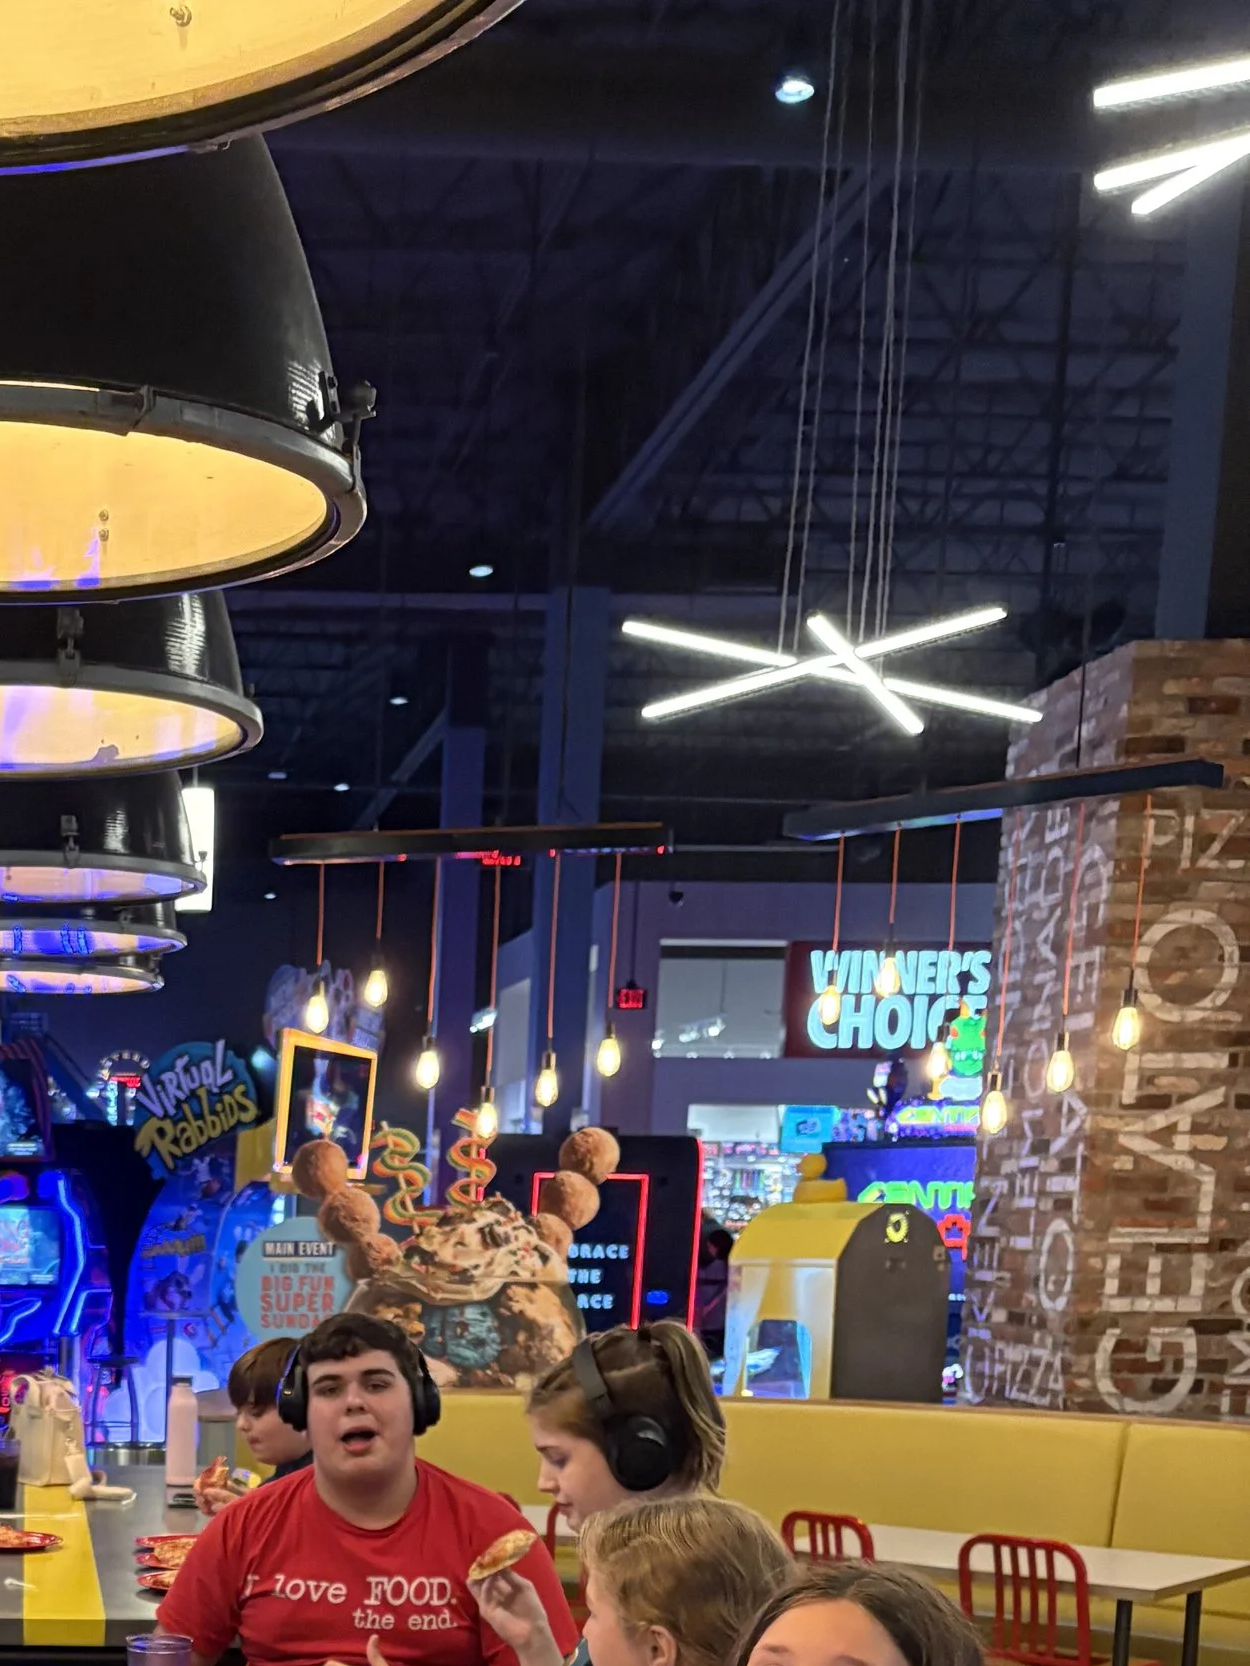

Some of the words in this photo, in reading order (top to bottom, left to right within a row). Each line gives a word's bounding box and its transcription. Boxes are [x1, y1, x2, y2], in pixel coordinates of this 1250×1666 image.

[810, 949, 992, 994] WINNER'S
[1095, 908, 1240, 1413] GELATO
[264, 1242, 295, 1256] MAIN
[299, 1242, 335, 1256] EVENT
[305, 1263, 326, 1273] THE
[567, 1268, 602, 1284] THE
[261, 1275, 292, 1292] BIG
[298, 1275, 335, 1292] FUN
[260, 1293, 335, 1312] SUPER
[240, 1574, 260, 1599] I
[271, 1573, 348, 1604] love
[363, 1576, 458, 1607] FOOD.
[352, 1607, 395, 1630] the
[407, 1607, 458, 1631] end.
